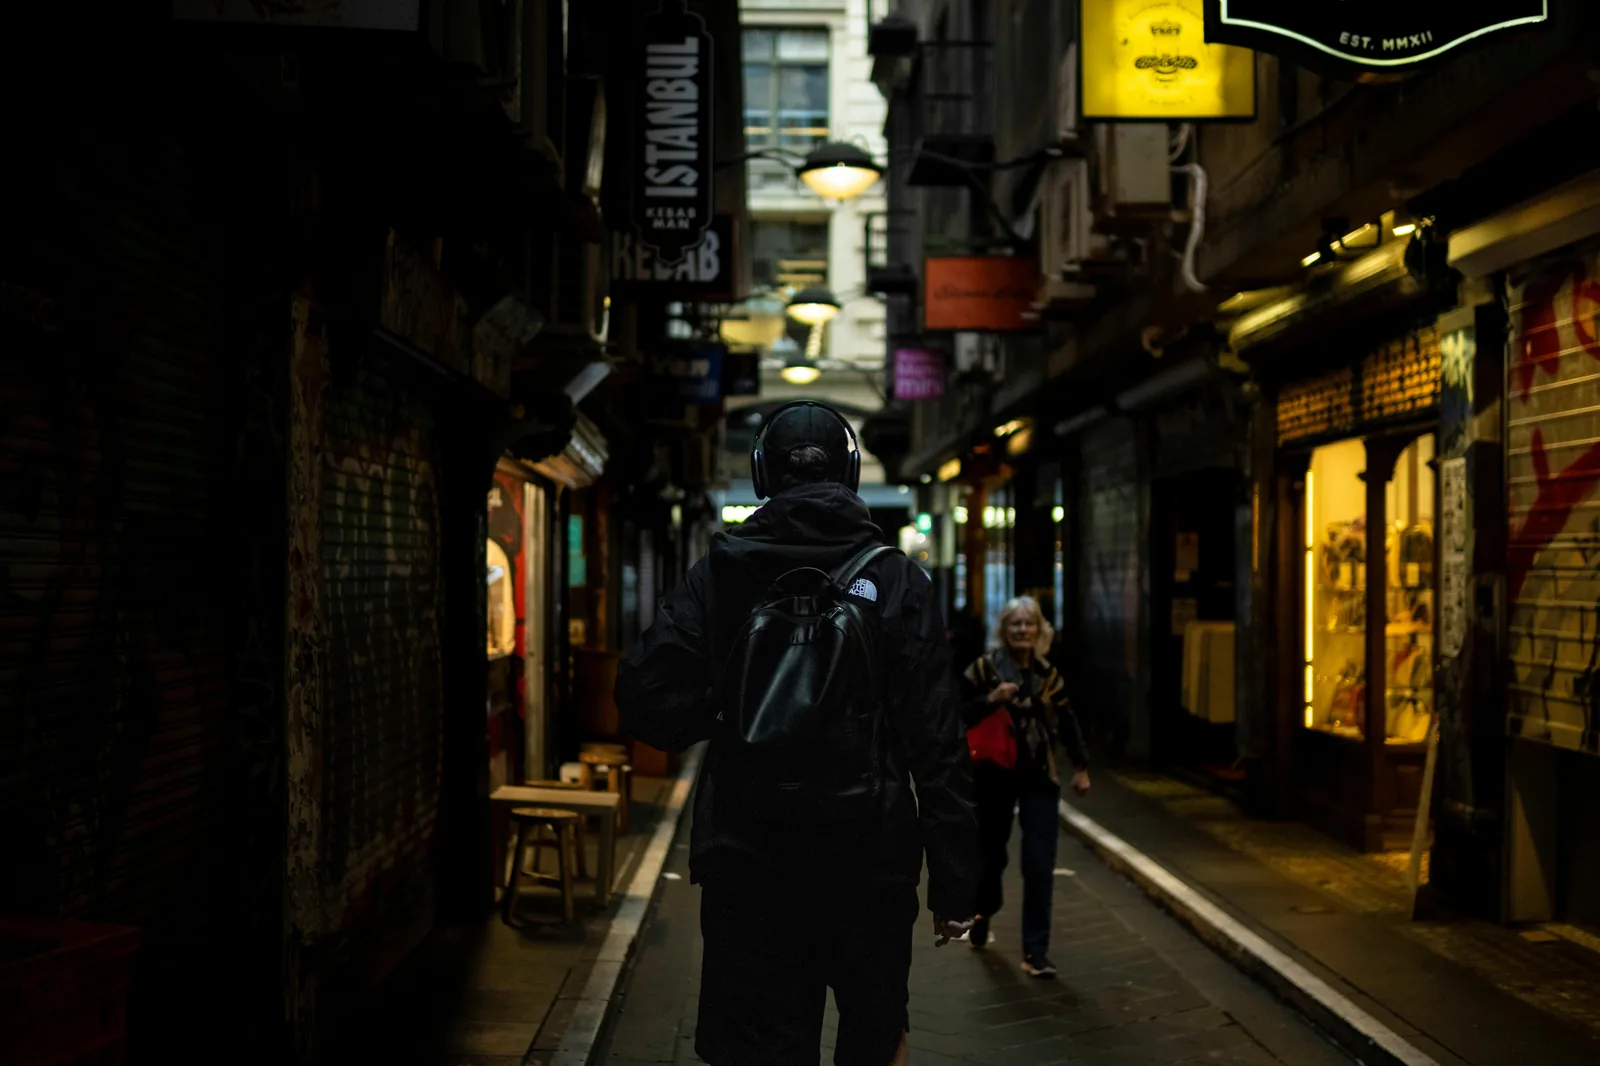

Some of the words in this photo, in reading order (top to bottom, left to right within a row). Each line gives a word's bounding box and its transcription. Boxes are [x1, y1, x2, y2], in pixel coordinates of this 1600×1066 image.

[1339, 31, 1374, 50] EST.
[1382, 30, 1433, 51] MMXII
[644, 35, 699, 197] ISTANBUL
[645, 206, 697, 218] KEBAB
[651, 218, 690, 230] MAN
[848, 588, 865, 597] ACE
